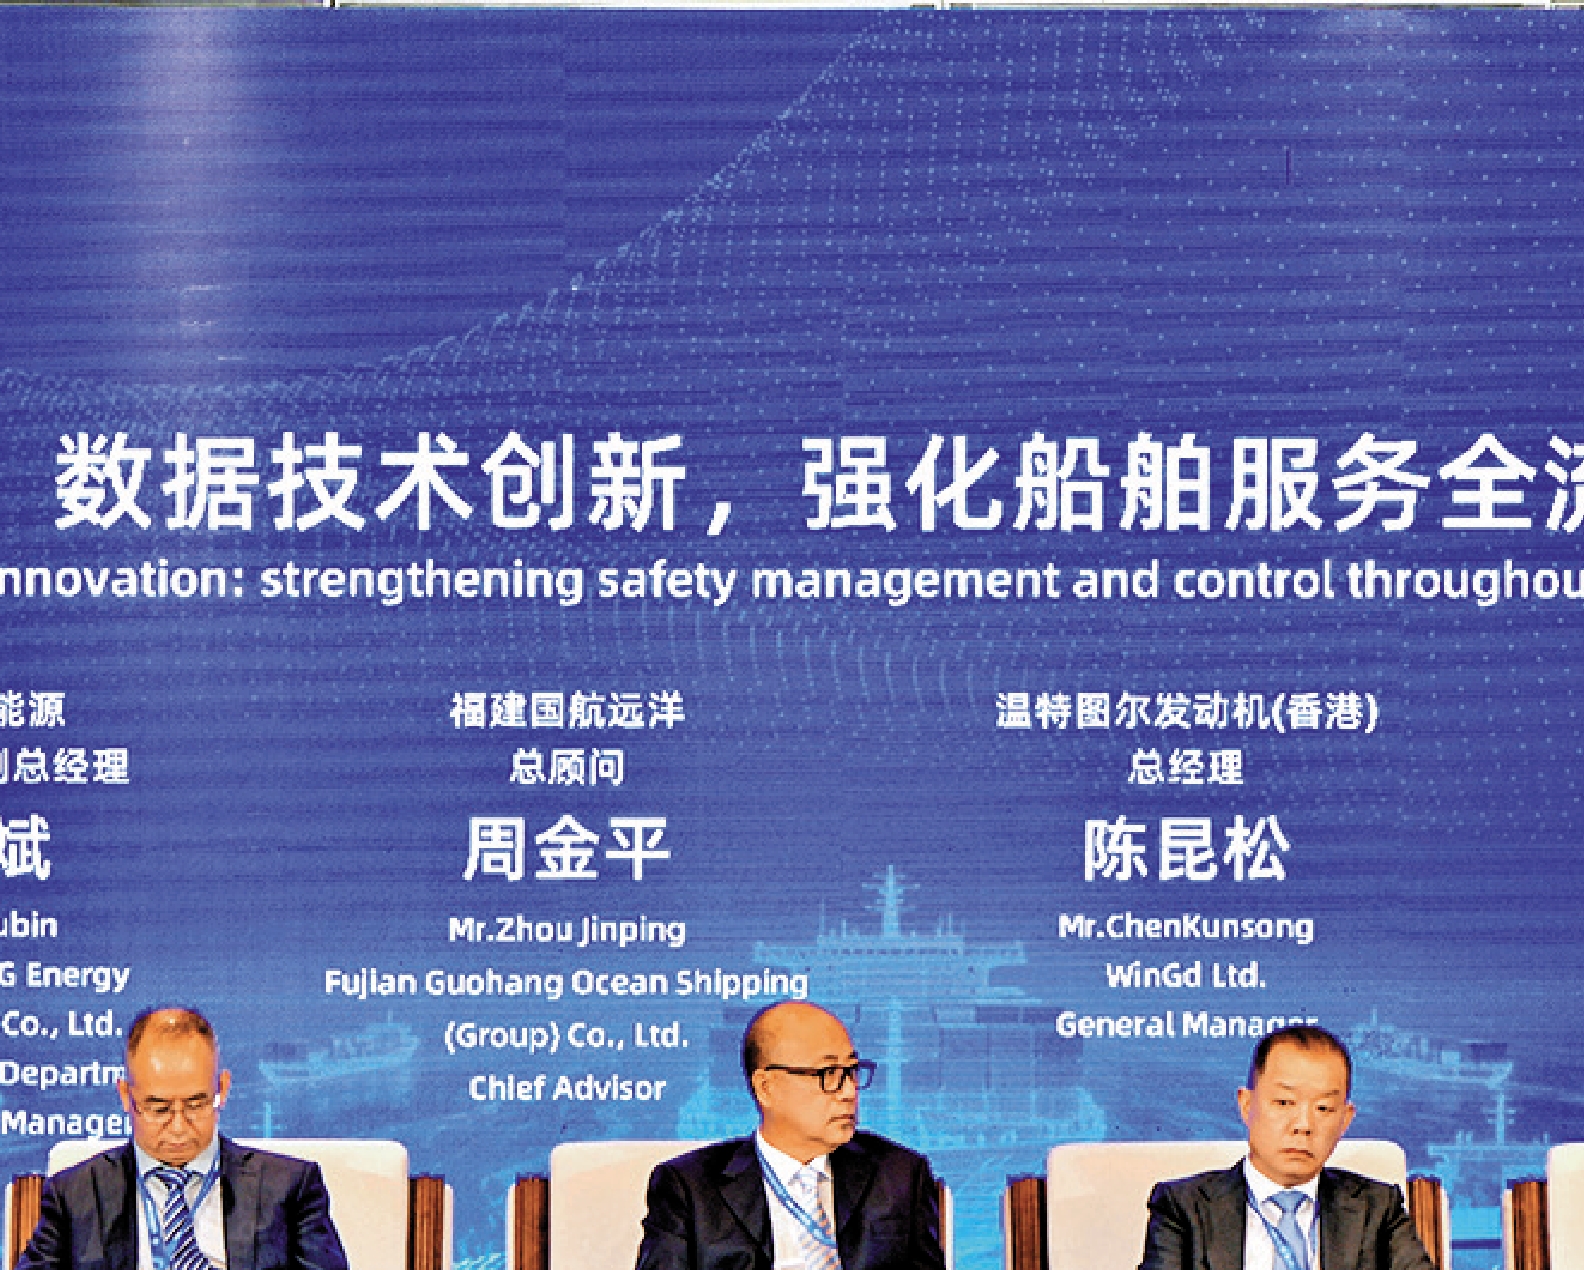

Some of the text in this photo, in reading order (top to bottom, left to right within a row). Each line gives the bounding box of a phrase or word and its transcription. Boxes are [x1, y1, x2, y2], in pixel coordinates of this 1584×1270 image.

[260, 558, 583, 607] strengthening
[598, 558, 736, 607] safety
[751, 562, 1060, 607] management
[1072, 558, 1158, 598] and
[1175, 558, 1335, 600] control
[449, 689, 686, 730] 福建国航远洋
[995, 689, 1378, 734] 温特图尔发动机(香港)
[509, 747, 624, 787] 总顾问
[1127, 747, 1244, 785] 总经理
[463, 814, 672, 883] 周金平
[1084, 814, 1290, 881] 陈昆松
[449, 915, 686, 948] Mr.Zhou Jinping
[1058, 912, 1314, 945] Mr.ChenKunsong
[27, 960, 130, 993] Energy
[325, 967, 808, 1000] Fujian Guohang Ocean Shipping
[1106, 960, 1266, 988] WinGd Ltd.
[1, 1010, 58, 1039] Co.,
[68, 1008, 123, 1036] Ltd.
[444, 1020, 688, 1056] (Group) Co., Ltd.
[1055, 1010, 1175, 1039] General
[0, 1061, 125, 1091] Departm
[468, 1073, 667, 1101] Chief Advisor
